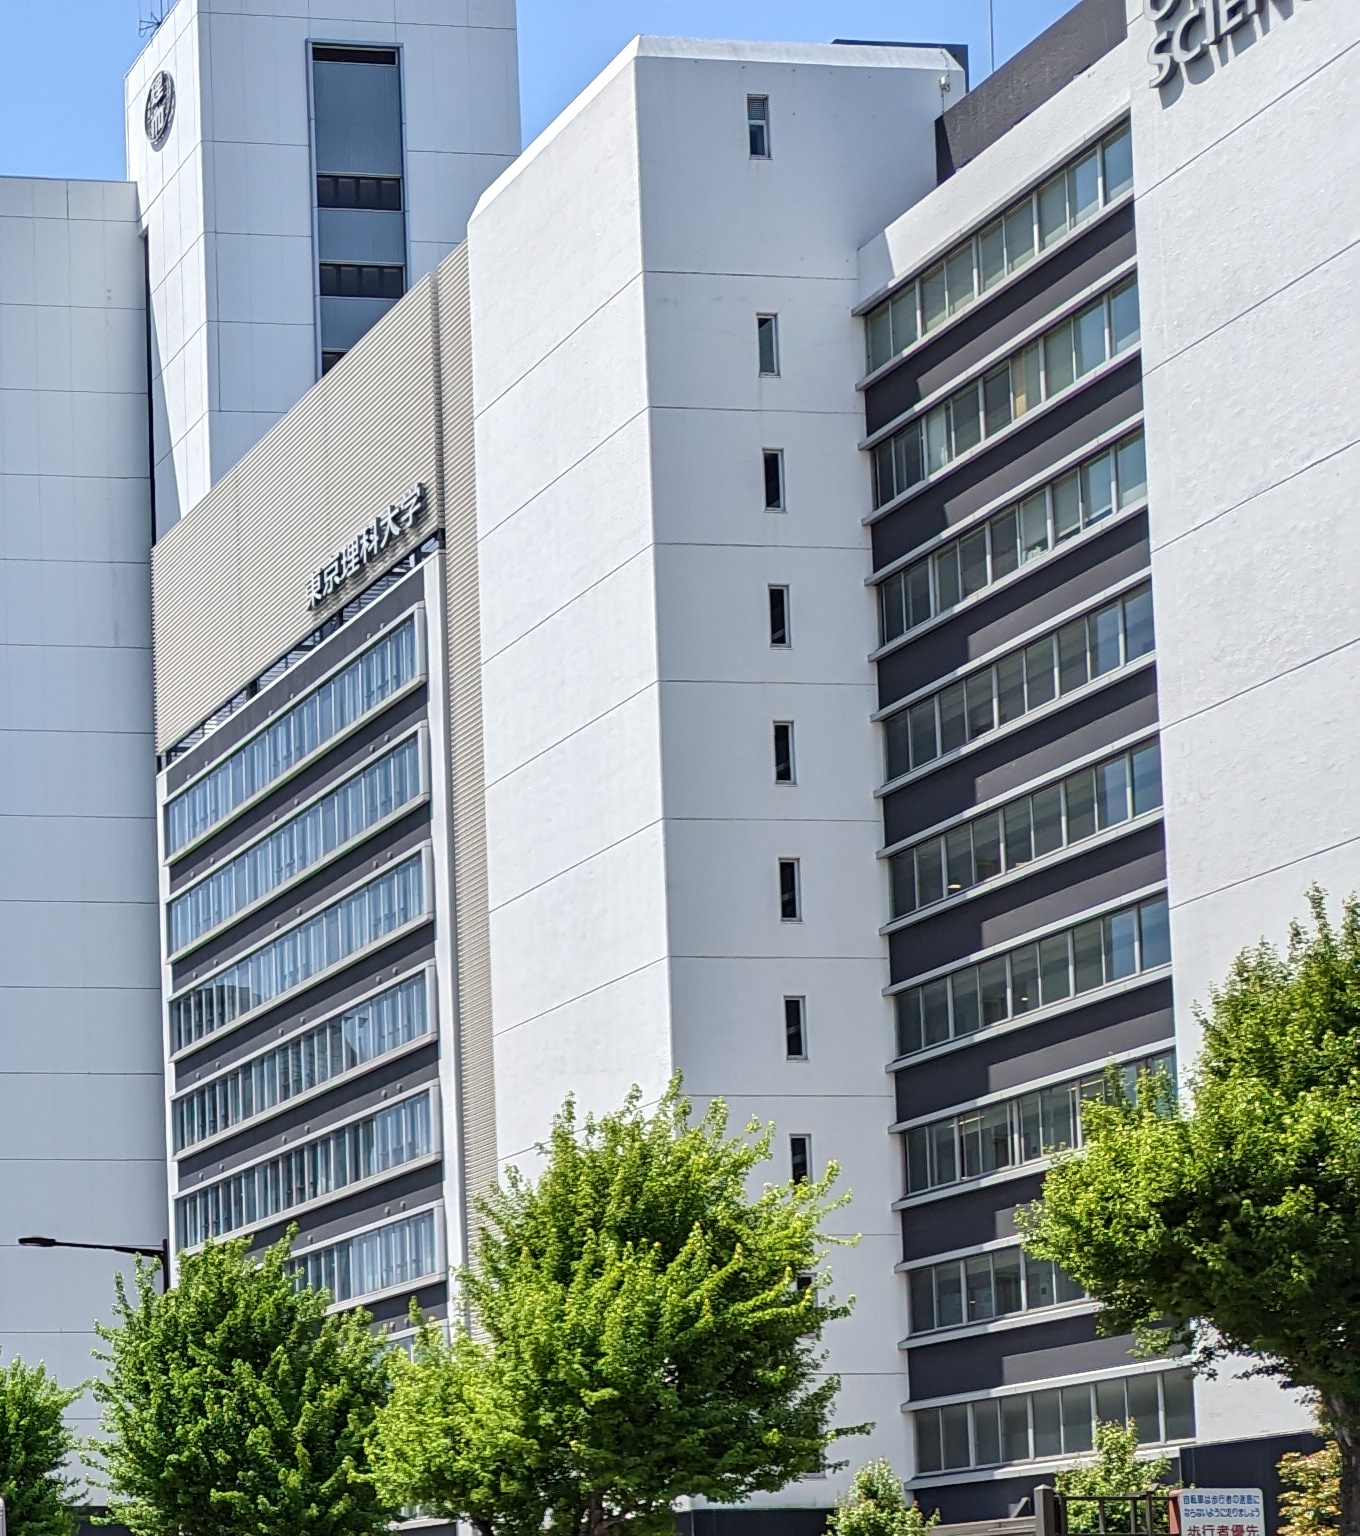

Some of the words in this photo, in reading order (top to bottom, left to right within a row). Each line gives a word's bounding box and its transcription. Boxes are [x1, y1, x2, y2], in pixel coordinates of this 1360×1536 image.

[1147, 0, 1260, 88] SCIE
[305, 482, 426, 609] 東京理科大学
